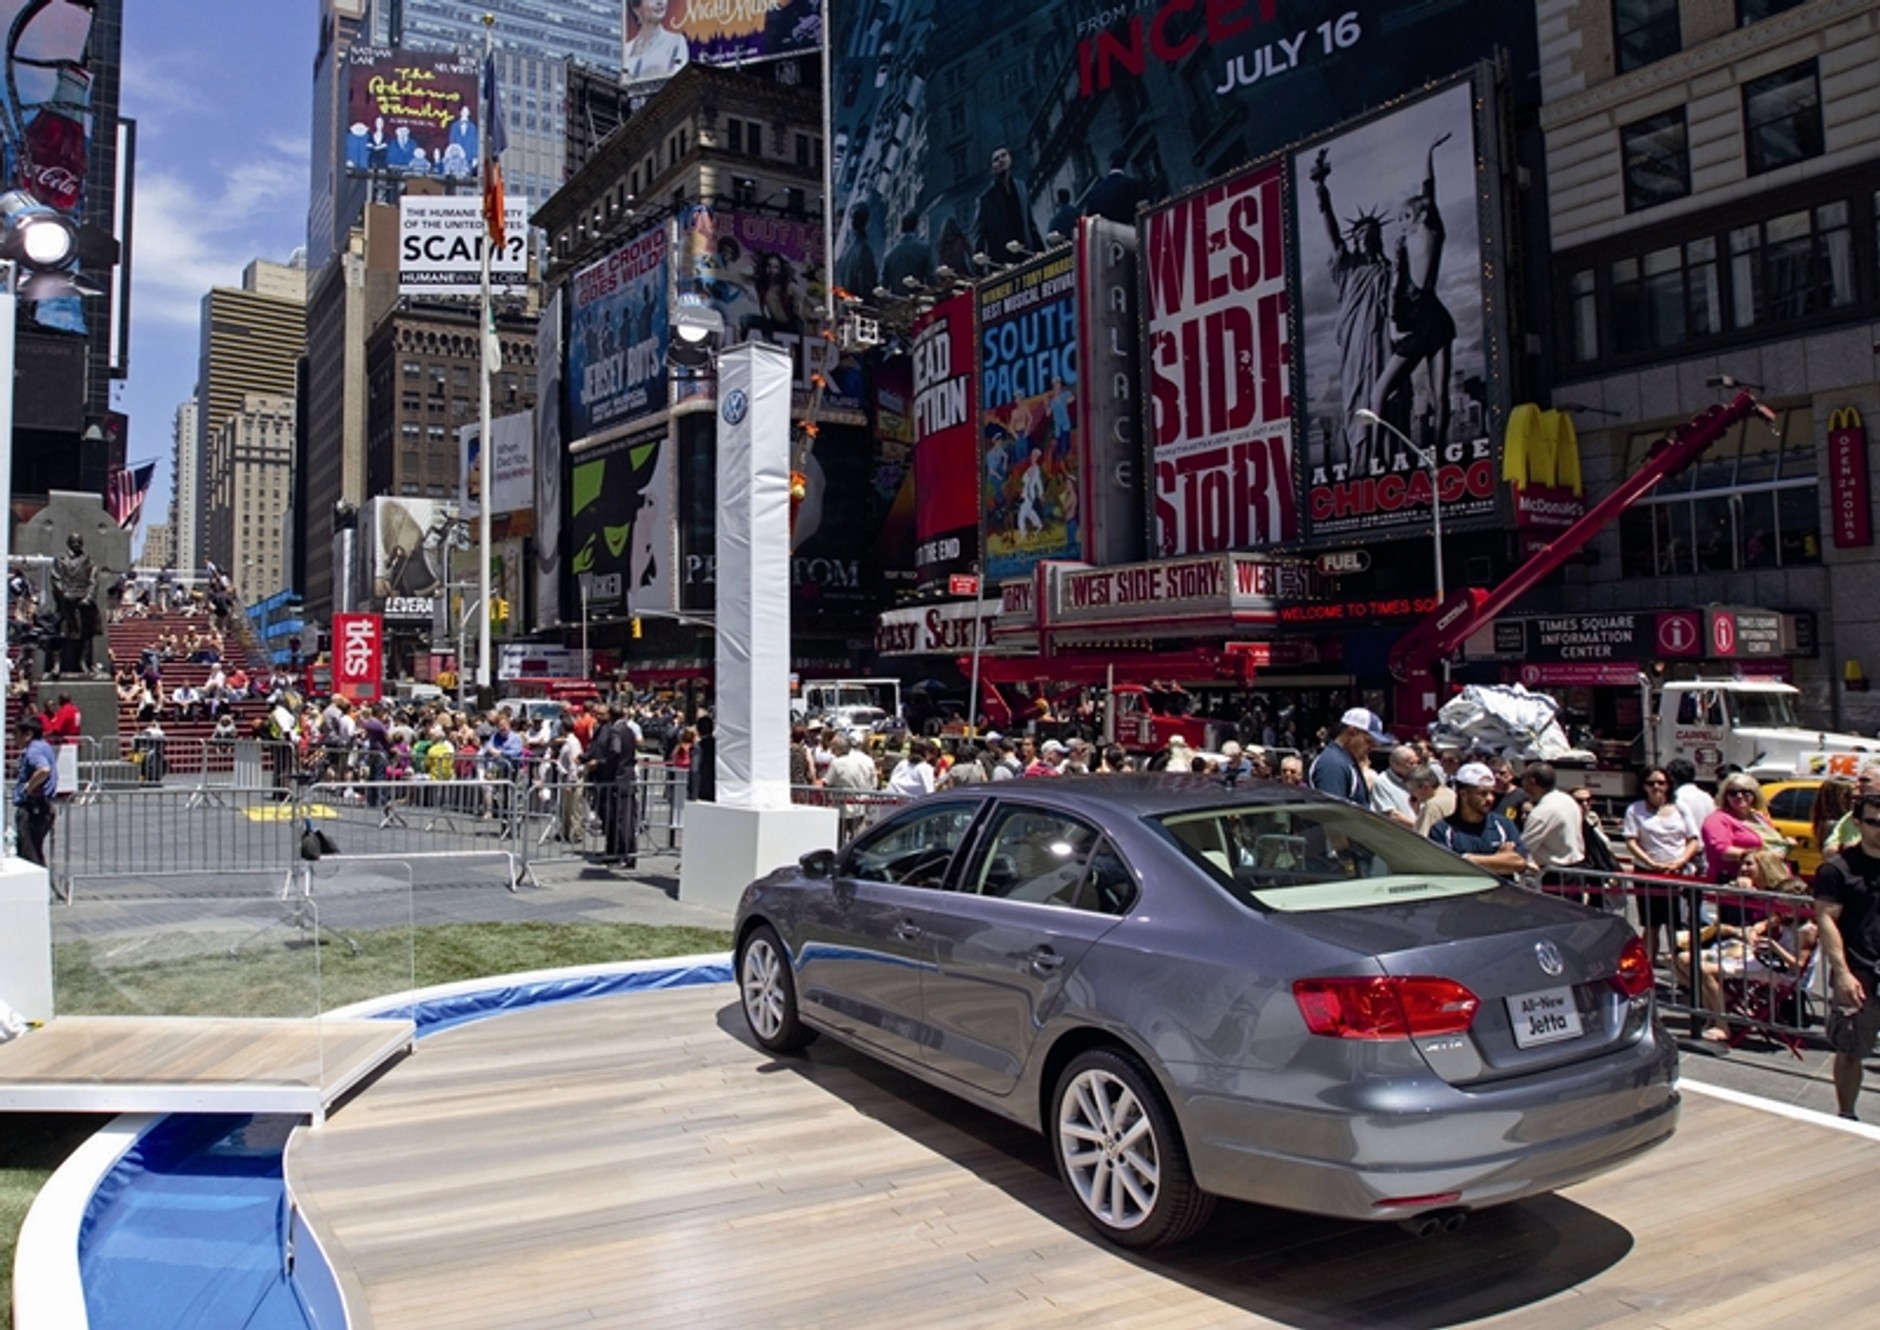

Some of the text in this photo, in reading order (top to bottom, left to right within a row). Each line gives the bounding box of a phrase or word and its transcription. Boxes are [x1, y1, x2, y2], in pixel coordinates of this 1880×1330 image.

[1076, 5, 1126, 36] FROM
[1077, 0, 1277, 97] INCE
[1216, 11, 1361, 95] JULY 16
[369, 75, 460, 101] Addams
[395, 67, 435, 80] The
[377, 96, 455, 129] Family
[404, 221, 418, 229] OF
[422, 221, 441, 229] THE
[444, 221, 484, 229] UNITED
[406, 208, 426, 217] THE
[429, 208, 476, 217] HUMANE
[577, 227, 666, 288] THE CROWD
[1149, 183, 1283, 321] WEST
[578, 273, 617, 306] GOES
[982, 301, 1002, 322] BEST
[1003, 286, 1040, 313] MUSICAL
[983, 297, 1077, 368] SOUTH
[627, 339, 660, 386] BOYS
[983, 340, 1077, 411] PACIFIC
[1109, 241, 1133, 488] PALACE
[1149, 290, 1292, 447] SIDE
[1312, 438, 1490, 485] AT LARGE
[1839, 435, 1851, 476] OPEN
[1154, 435, 1296, 557] STORY
[1309, 459, 1495, 521] CHICAGO
[1842, 491, 1855, 540] HOURS
[1070, 561, 1219, 606] WEST SIDE STORY
[1323, 555, 1362, 571] FUEL
[1281, 605, 1344, 620] WELCOME
[1348, 603, 1366, 616] TO
[1369, 600, 1411, 616] TIMES
[1538, 616, 1635, 632] TIMES SQUARE
[345, 618, 375, 676] tkts
[1541, 630, 1633, 646] INFORMATION
[1560, 646, 1612, 659] CENTER
[1522, 996, 1565, 1014] All-New
[1529, 1012, 1567, 1036] Jetta
